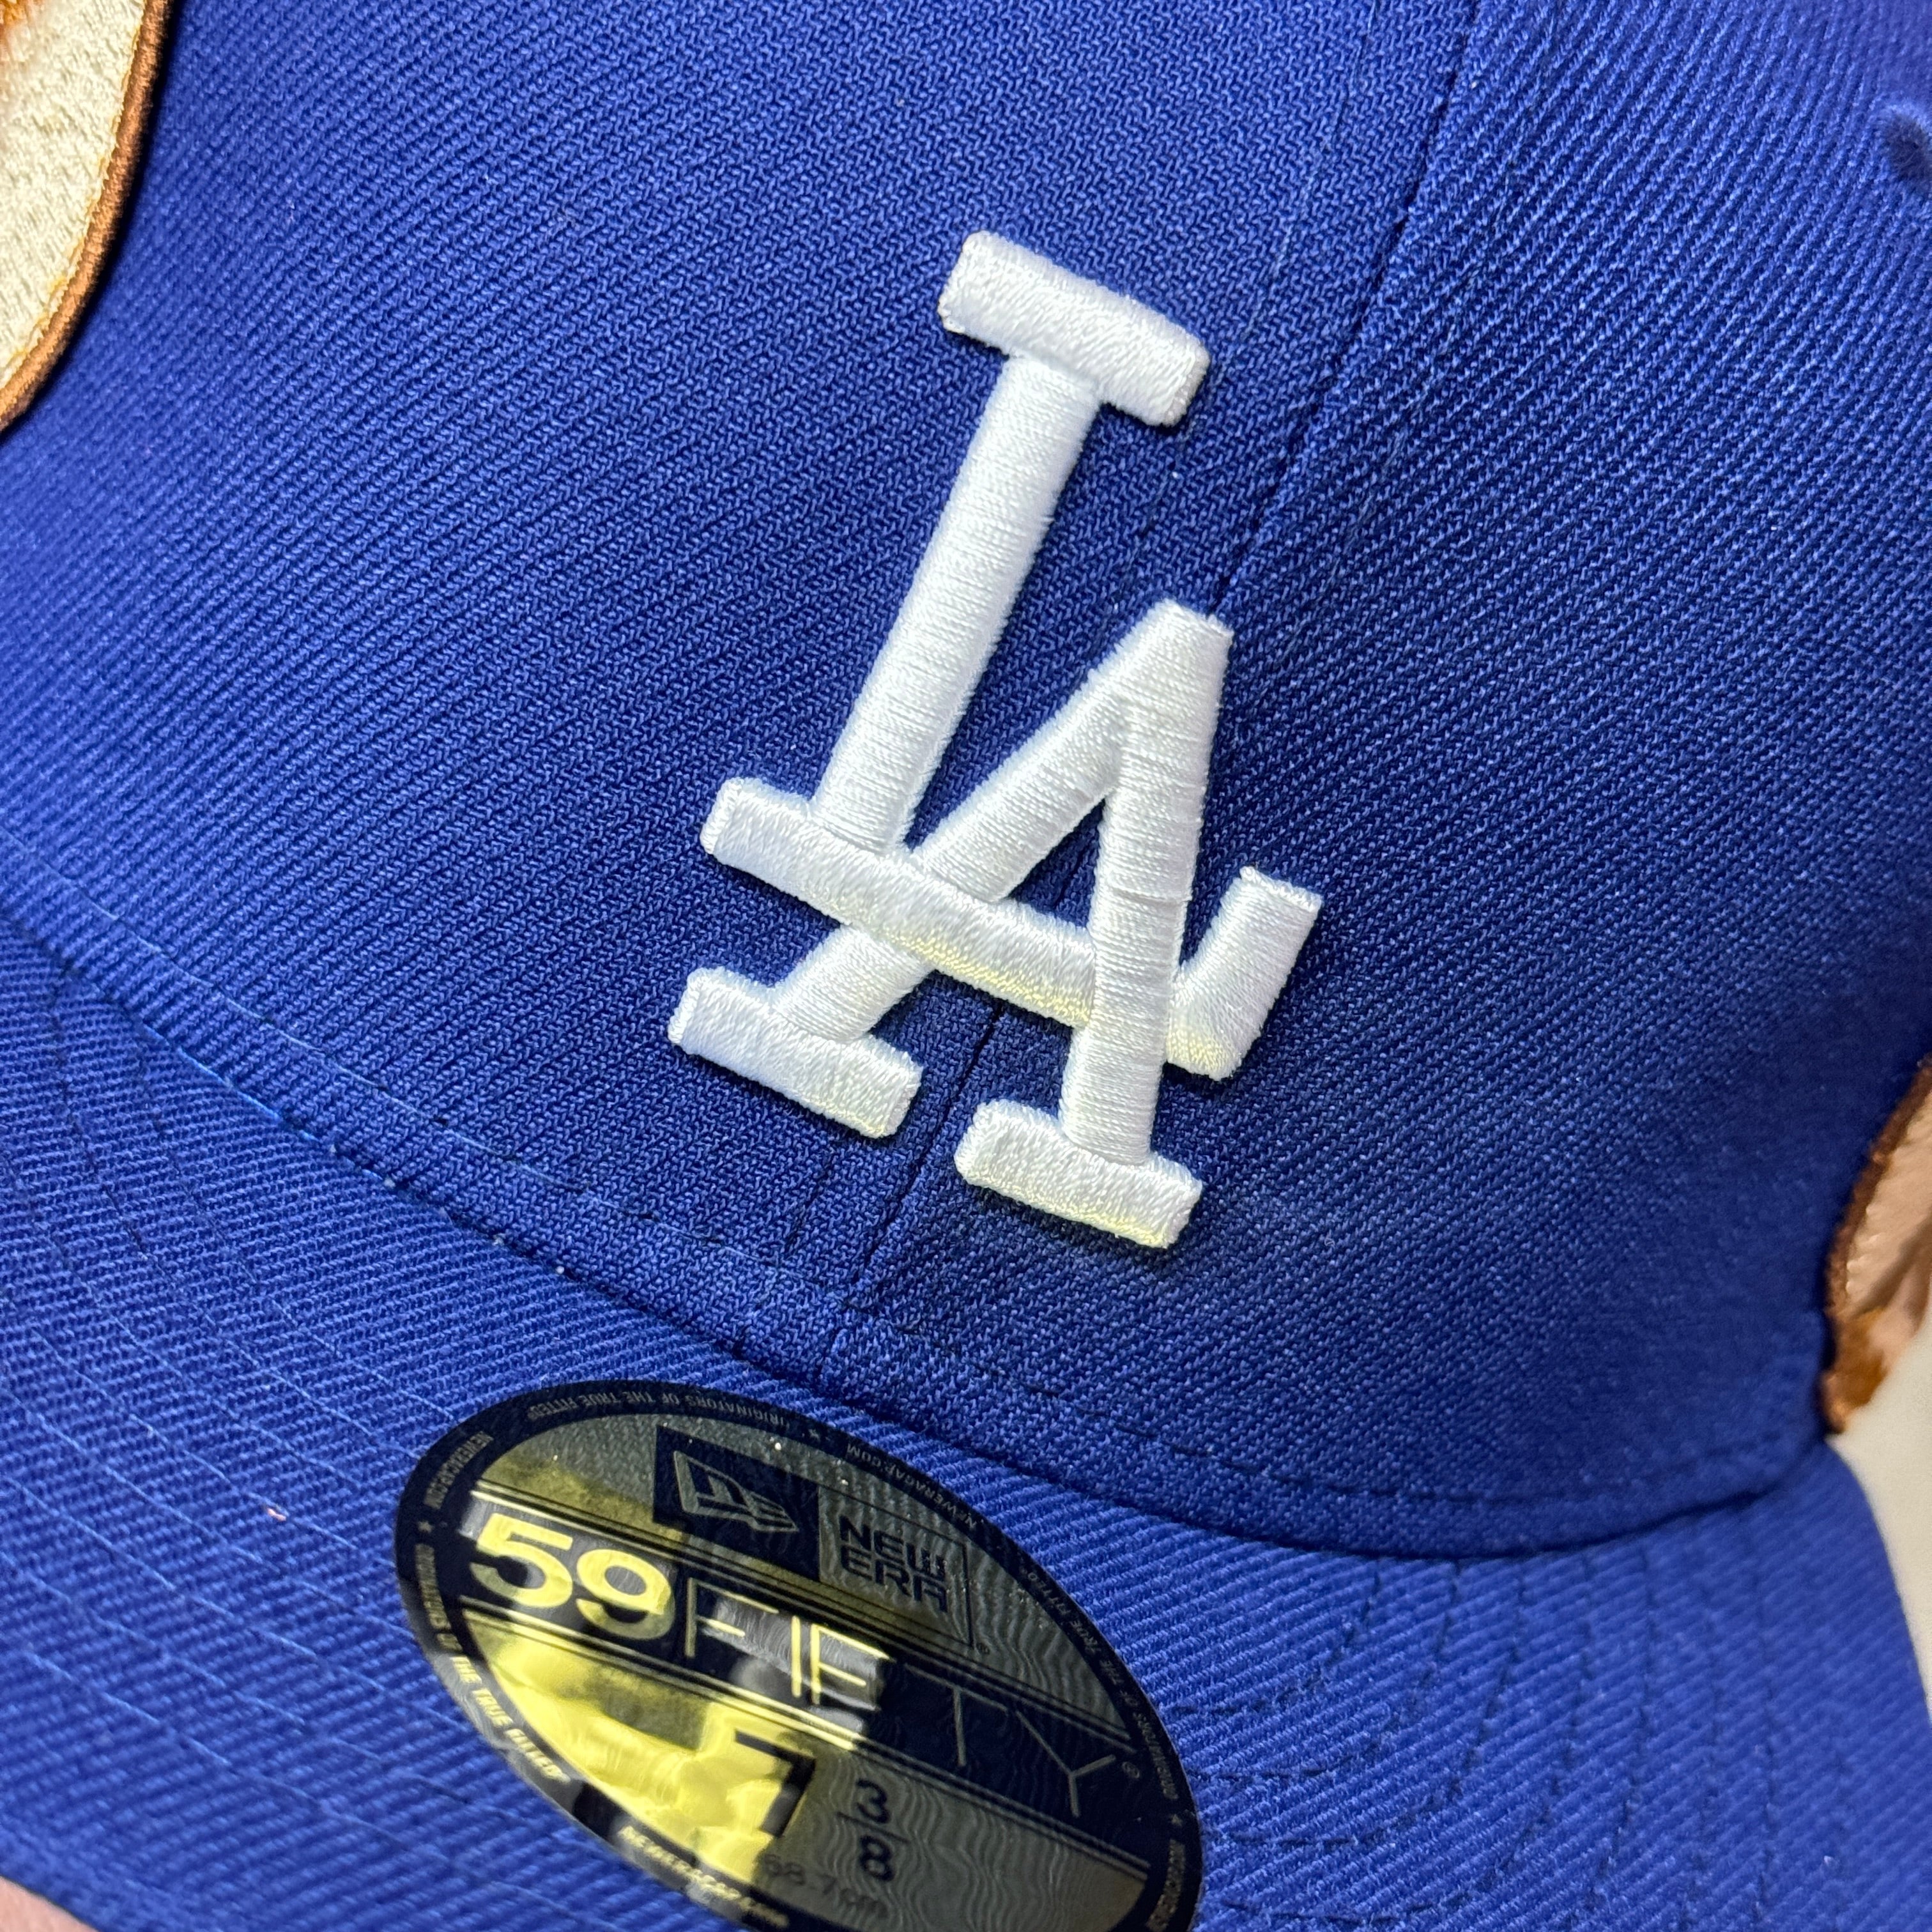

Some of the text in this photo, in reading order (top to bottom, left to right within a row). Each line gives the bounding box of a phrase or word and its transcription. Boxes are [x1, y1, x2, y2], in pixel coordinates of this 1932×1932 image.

[667, 230, 1322, 1249] LA
[578, 1392, 621, 1406] TRUE
[623, 1391, 656, 1404] THE
[839, 1515, 946, 1579] NEW
[839, 1544, 948, 1614] ERA
[735, 1729, 816, 1838] 7
